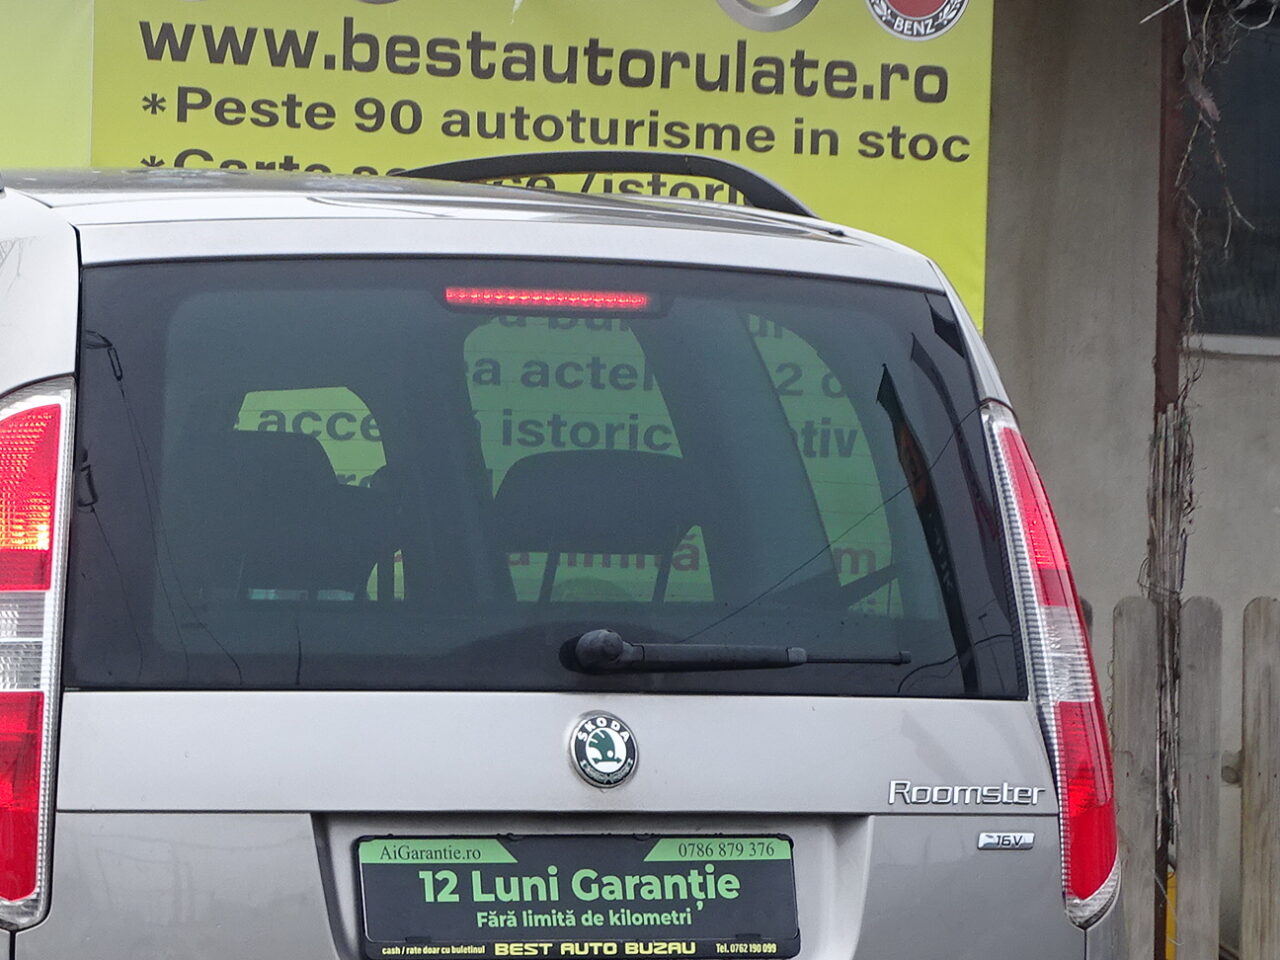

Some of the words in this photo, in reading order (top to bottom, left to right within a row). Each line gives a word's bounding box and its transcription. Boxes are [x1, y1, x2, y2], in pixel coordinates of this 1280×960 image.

[893, 16, 936, 36] BENZ
[139, 17, 949, 103] www.bestautorulate.ro
[354, 97, 423, 135] 90
[441, 106, 776, 154] autoturisme
[793, 117, 839, 156] in
[857, 125, 971, 163] stoc
[888, 780, 1047, 806] Roomster
[678, 843, 714, 858] 0786
[718, 842, 744, 857] 879
[749, 842, 775, 857] 376
[995, 835, 1023, 847] 16V
[380, 845, 481, 860] AiGarantie.ro
[419, 869, 460, 902] 12
[472, 865, 560, 902] Luni
[572, 863, 741, 911] Garanție
[476, 910, 518, 928] Fără
[522, 908, 577, 928] limită
[581, 909, 605, 927] de
[608, 907, 692, 926] kilometri
[381, 946, 401, 955] cash
[406, 946, 422, 955] rate
[422, 945, 440, 955] doar
[451, 945, 486, 954] buletinul
[494, 942, 553, 956] BEST
[560, 941, 618, 955] AUTO
[625, 941, 696, 955] BUZAU
[715, 942, 729, 953] Tel.
[730, 943, 749, 953] 0762
